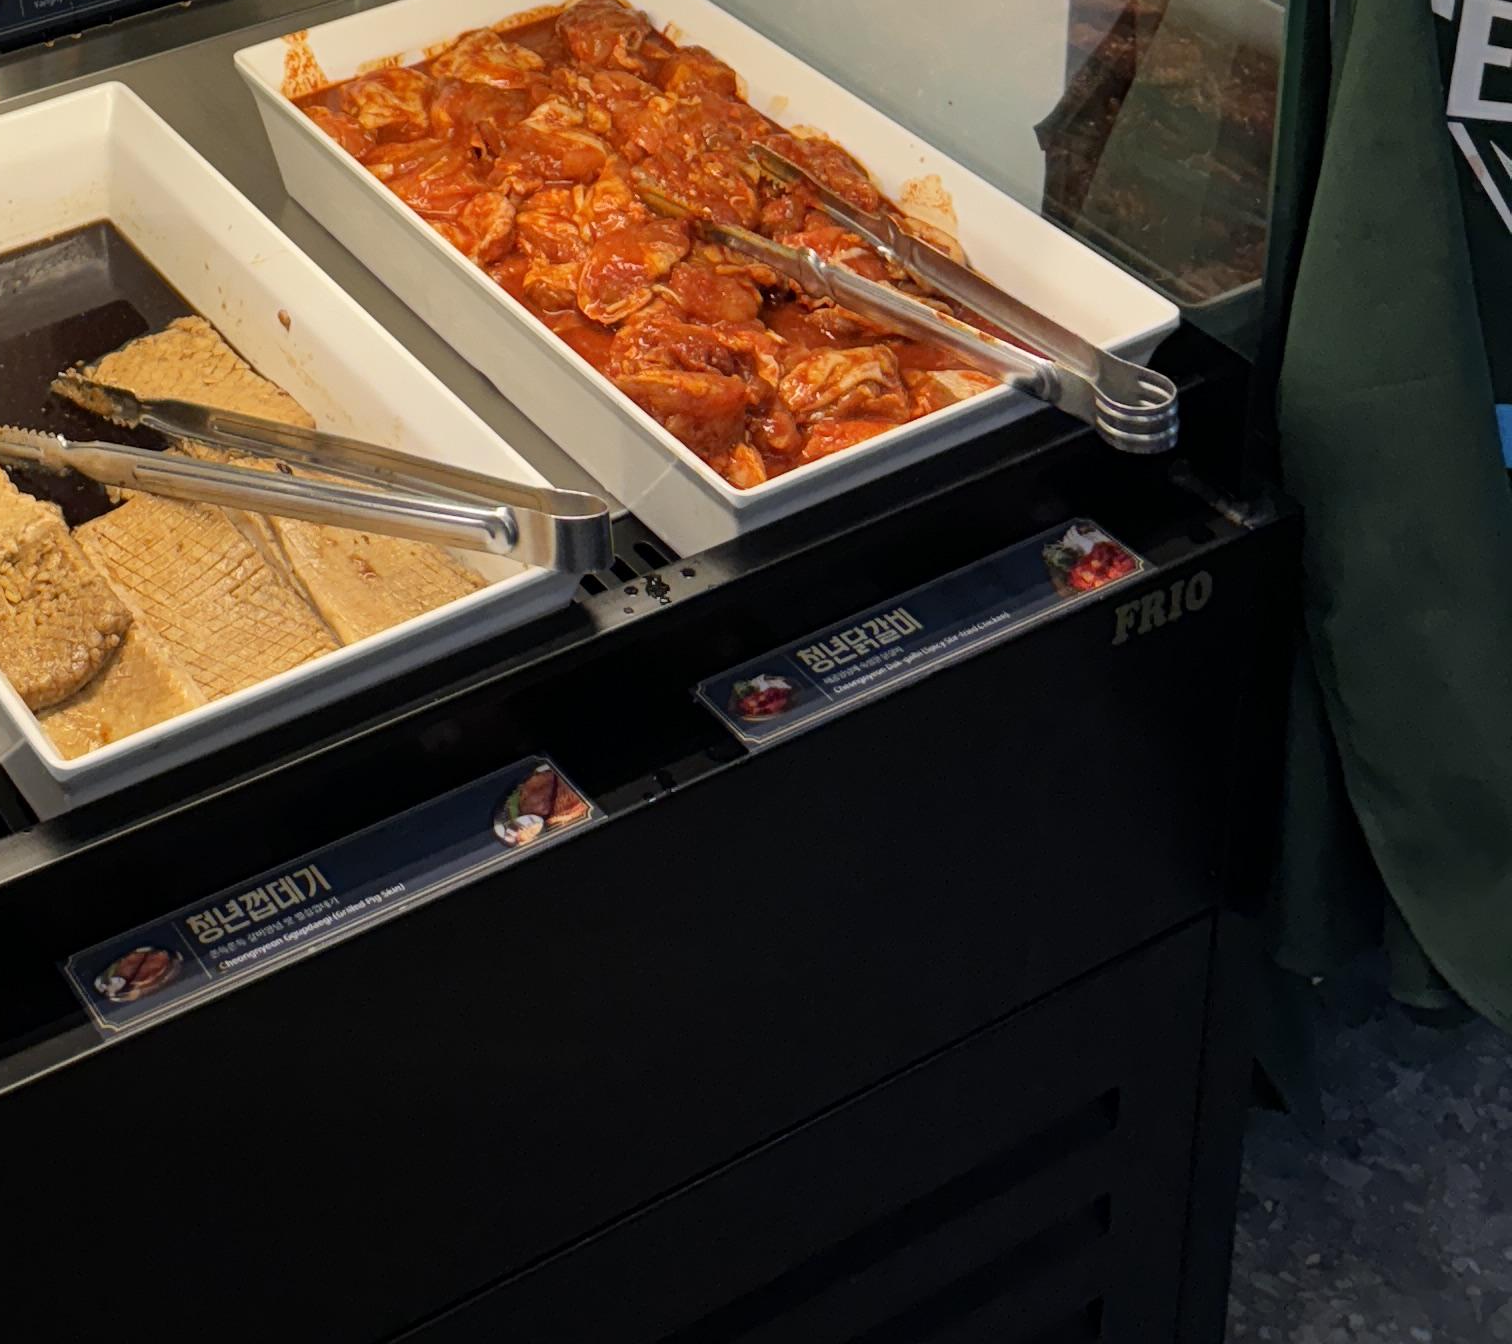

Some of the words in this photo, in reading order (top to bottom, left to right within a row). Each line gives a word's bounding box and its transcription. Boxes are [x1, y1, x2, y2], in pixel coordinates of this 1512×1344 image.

[797, 608, 923, 676] 청년닭갈비
[1112, 570, 1213, 645] FRIO
[219, 938, 284, 969] Cheongnyeon
[365, 895, 382, 905] Pig
